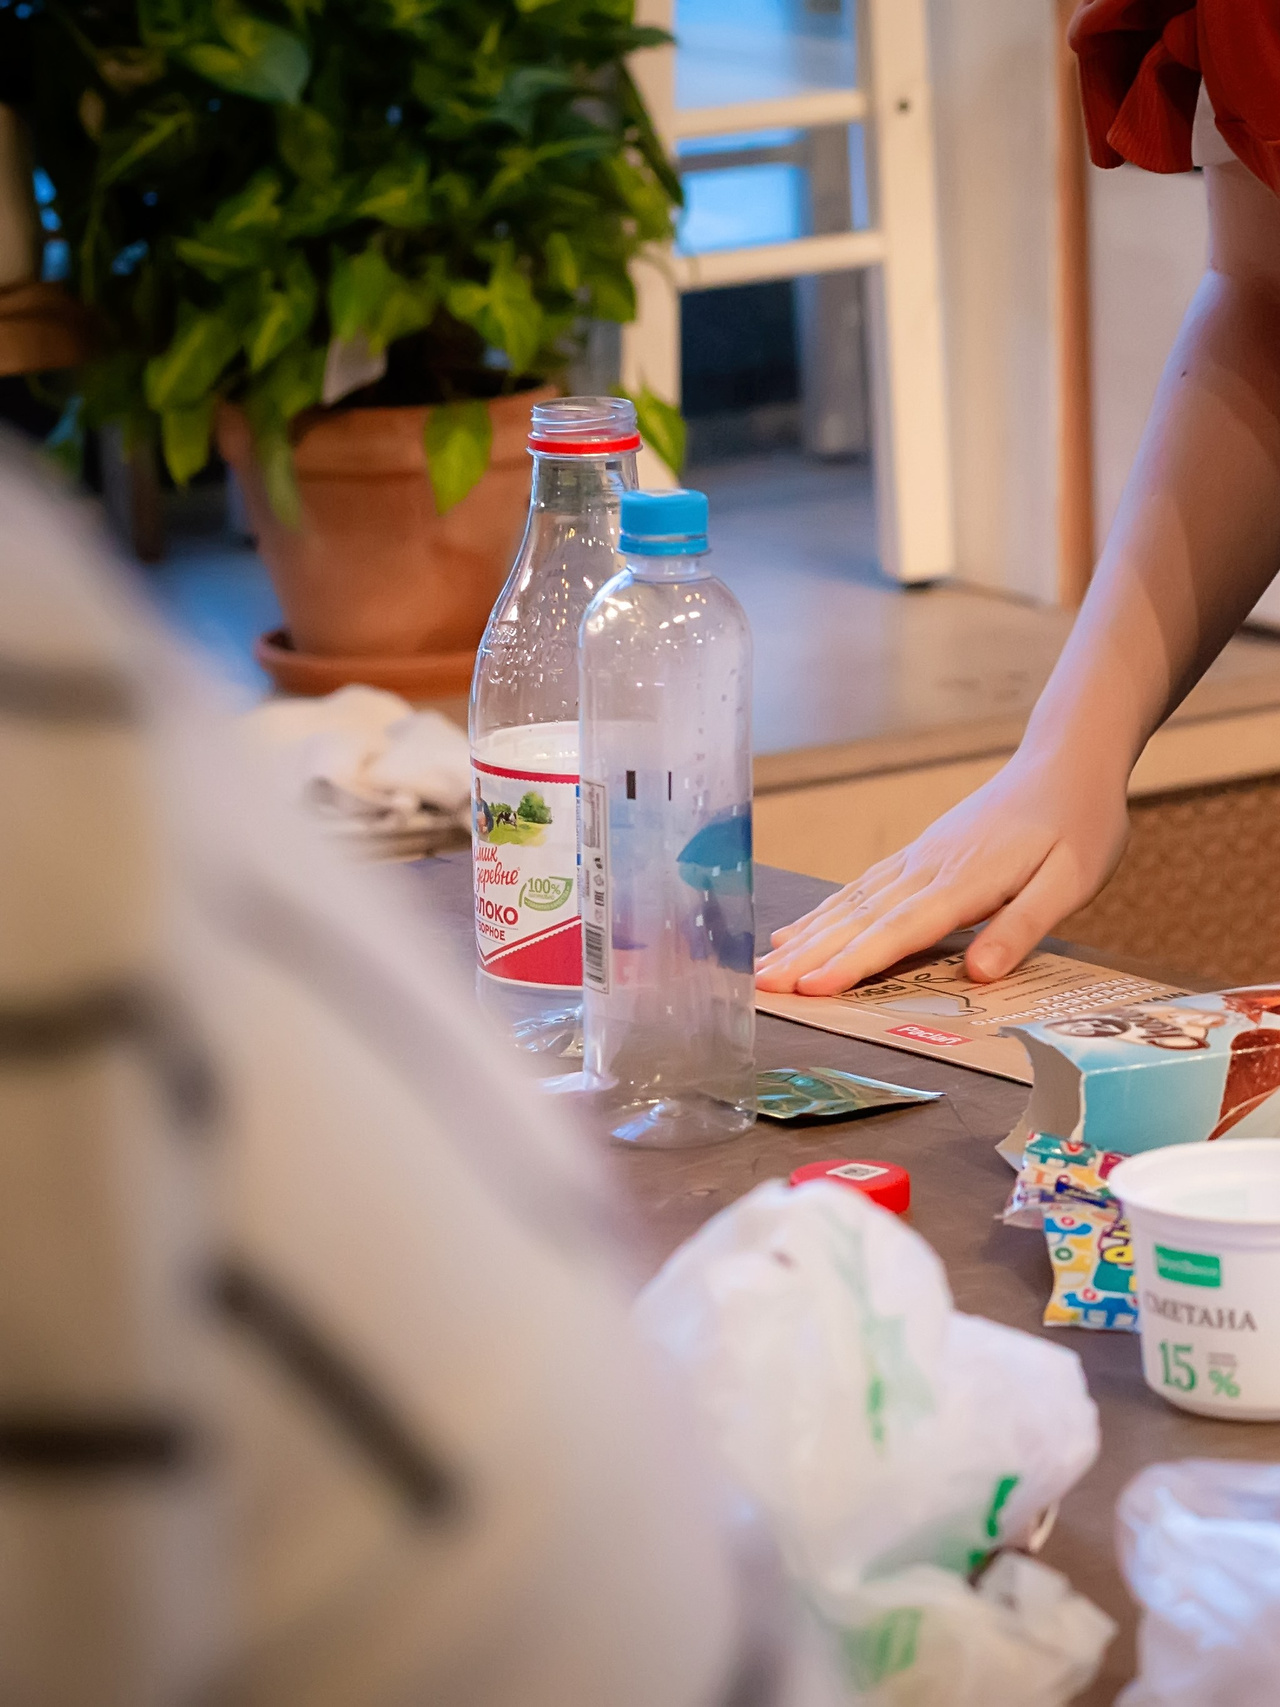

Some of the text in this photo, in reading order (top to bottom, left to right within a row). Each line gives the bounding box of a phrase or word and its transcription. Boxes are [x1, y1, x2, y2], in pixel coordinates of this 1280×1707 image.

[528, 877, 561, 895] 100%
[840, 983, 907, 999] 55%
[1071, 986, 1167, 1015] САЛФЕТКИ
[896, 1026, 963, 1046] Paclan
[1159, 1339, 1198, 1392] 15
